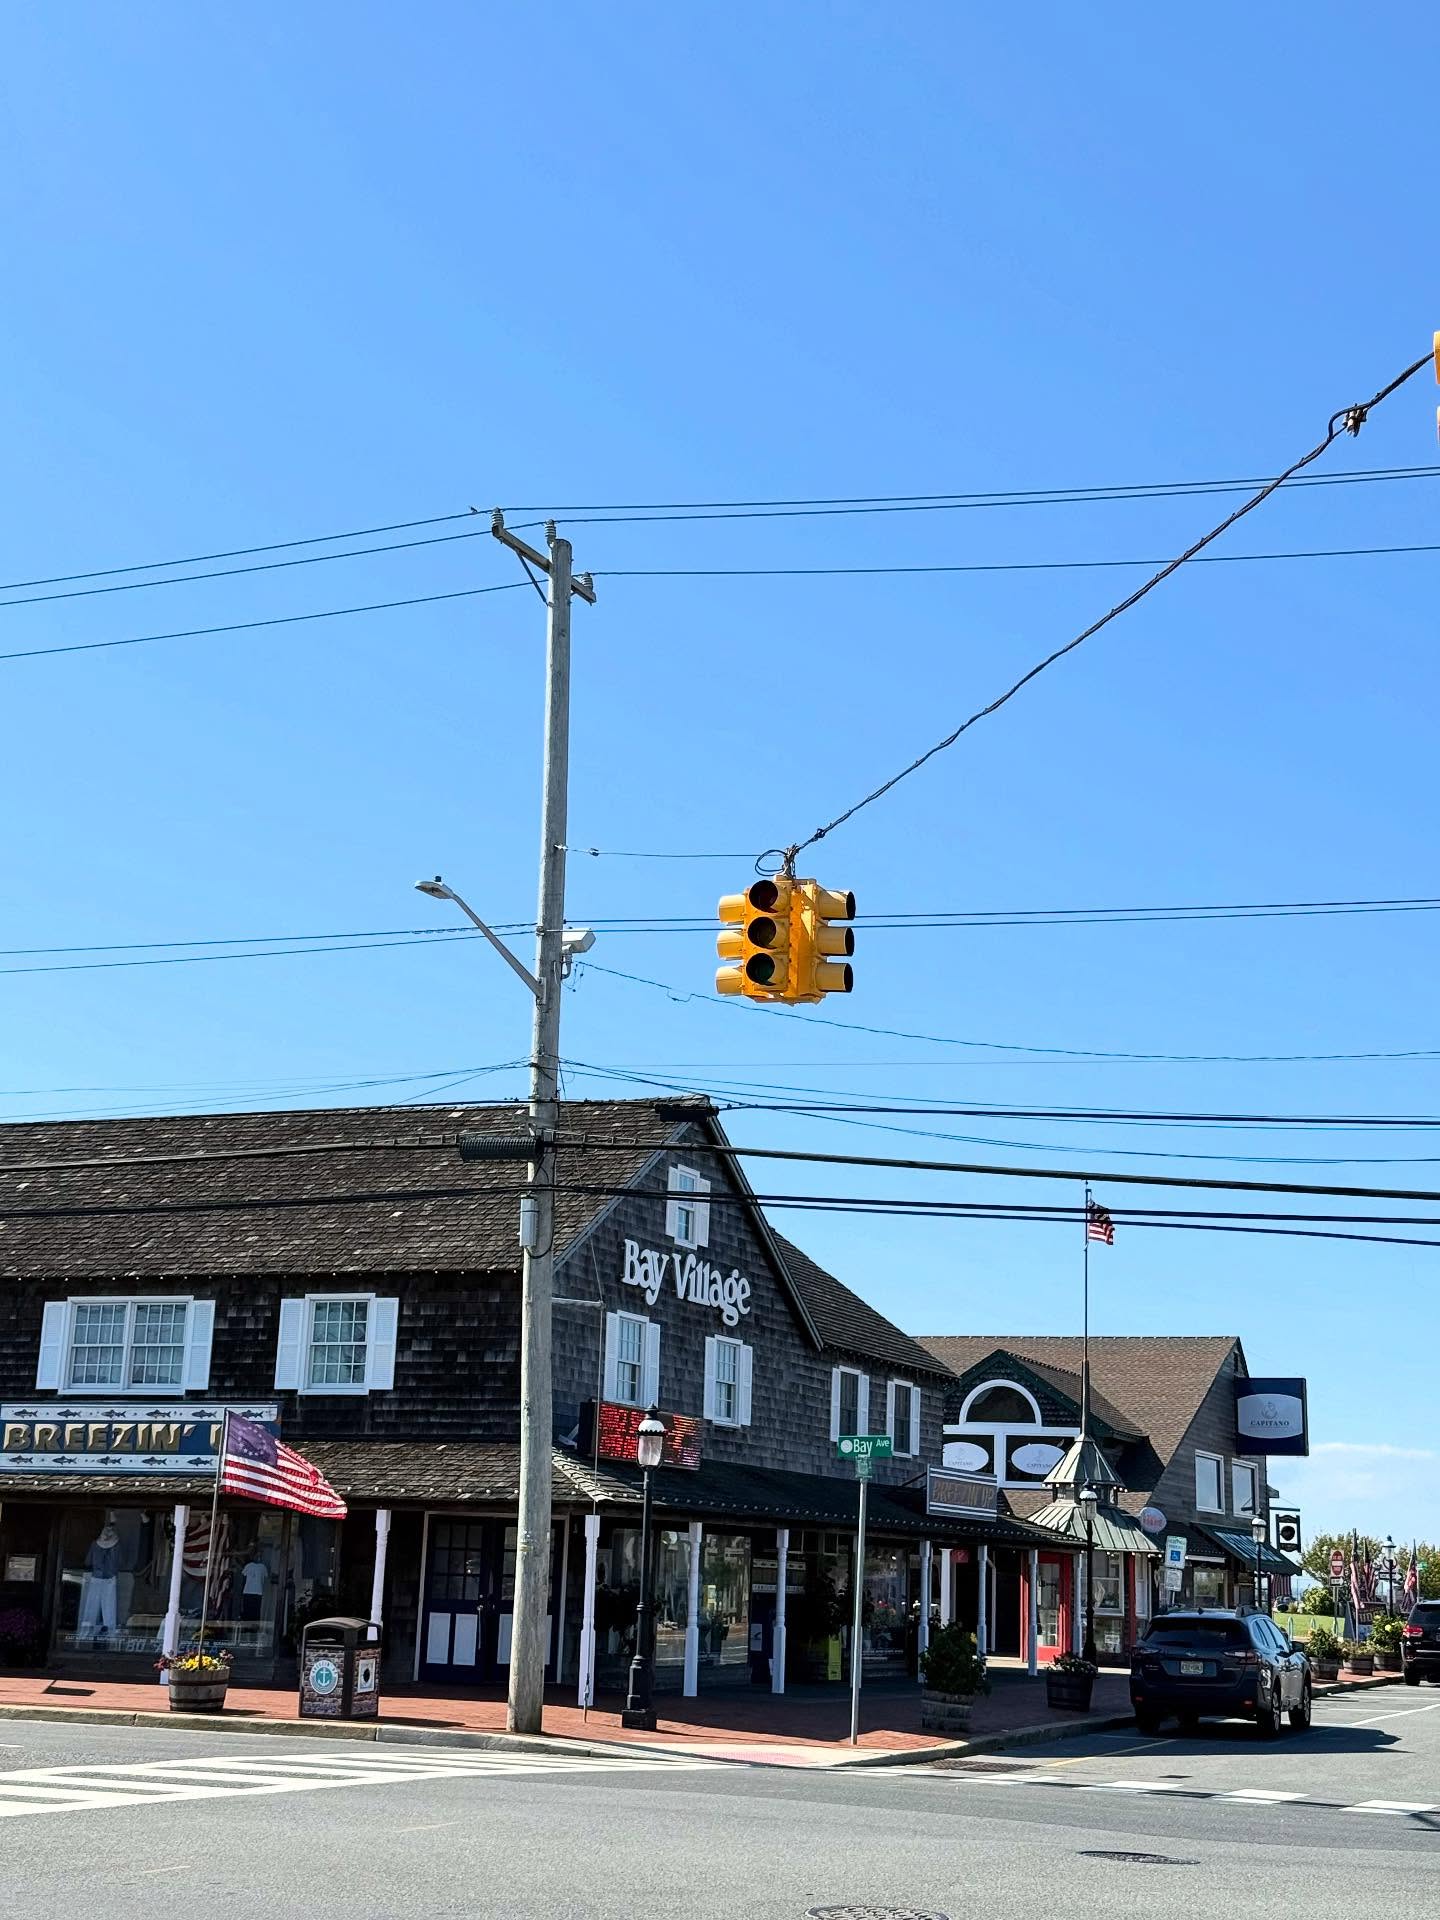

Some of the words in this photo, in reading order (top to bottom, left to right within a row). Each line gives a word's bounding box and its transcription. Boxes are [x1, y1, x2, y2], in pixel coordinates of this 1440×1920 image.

[621, 1238, 669, 1306] Bay
[672, 1253, 751, 1326] Village
[1250, 1419, 1290, 1427] CAPITANO
[3, 1422, 197, 1452] BREEZIN'
[853, 1438, 873, 1456] Bay
[875, 1438, 890, 1448] Ave
